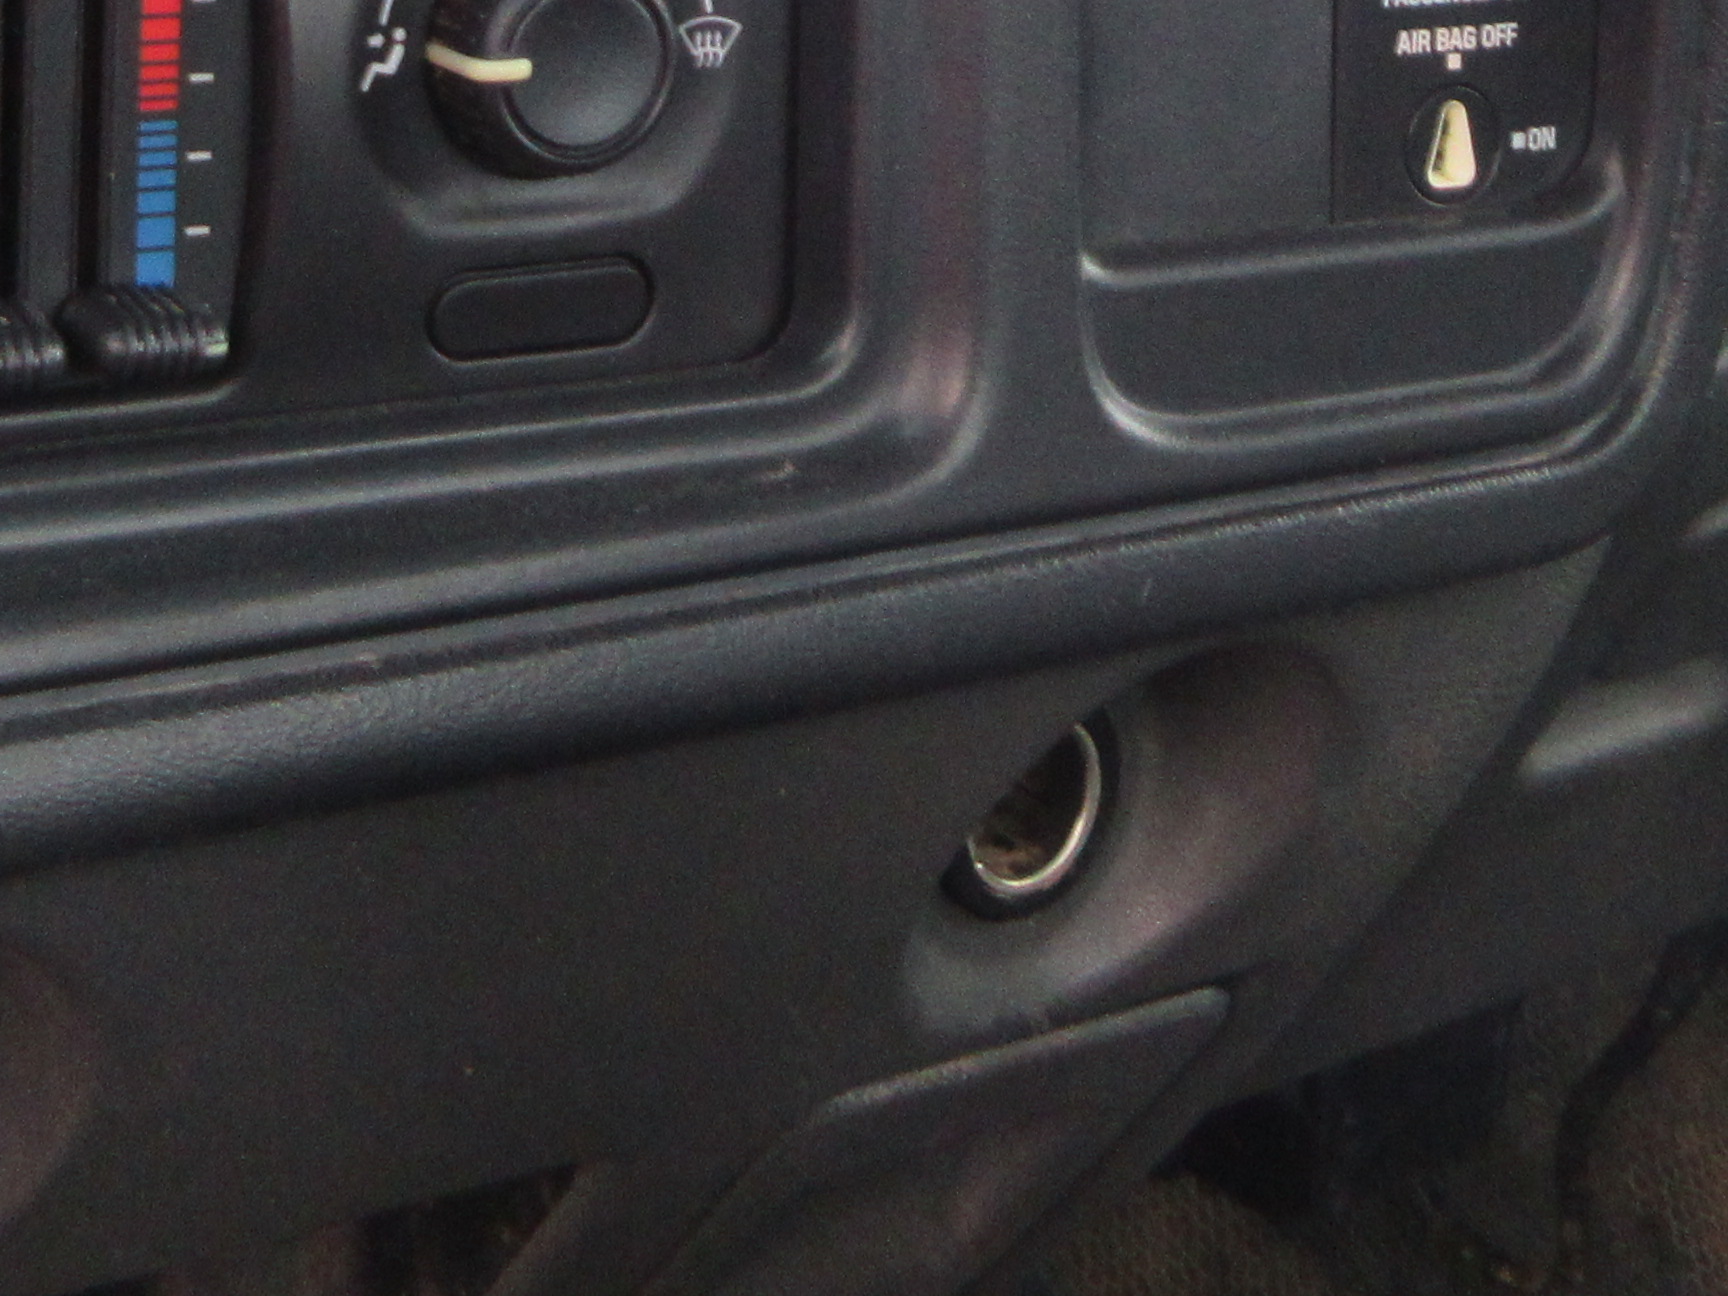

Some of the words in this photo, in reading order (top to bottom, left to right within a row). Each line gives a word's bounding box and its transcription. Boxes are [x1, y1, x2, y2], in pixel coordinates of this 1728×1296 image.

[1396, 28, 1432, 55] AIR
[1435, 26, 1477, 52] BAG
[1480, 22, 1518, 49] OFF
[1526, 126, 1557, 152] ON
